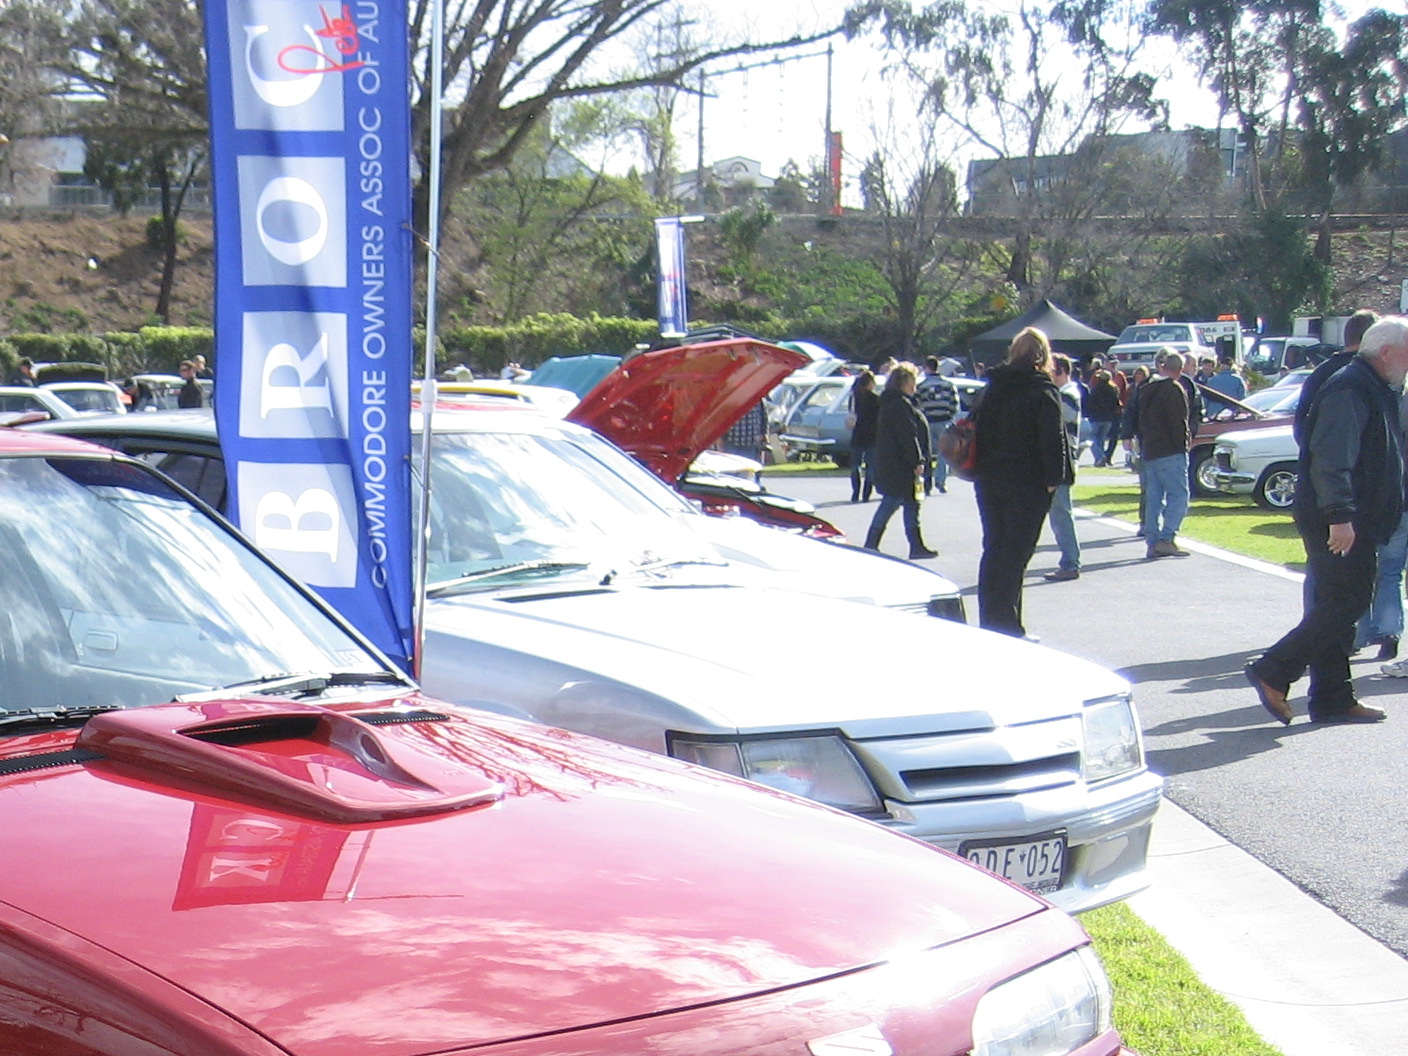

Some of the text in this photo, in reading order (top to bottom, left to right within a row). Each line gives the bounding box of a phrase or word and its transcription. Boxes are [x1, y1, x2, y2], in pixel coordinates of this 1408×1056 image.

[357, 51, 381, 95] OF
[358, 106, 384, 217] ASSOC
[361, 225, 386, 360] OWNERS
[362, 370, 387, 590] COMMODORE
[1026, 840, 1062, 877] 052
